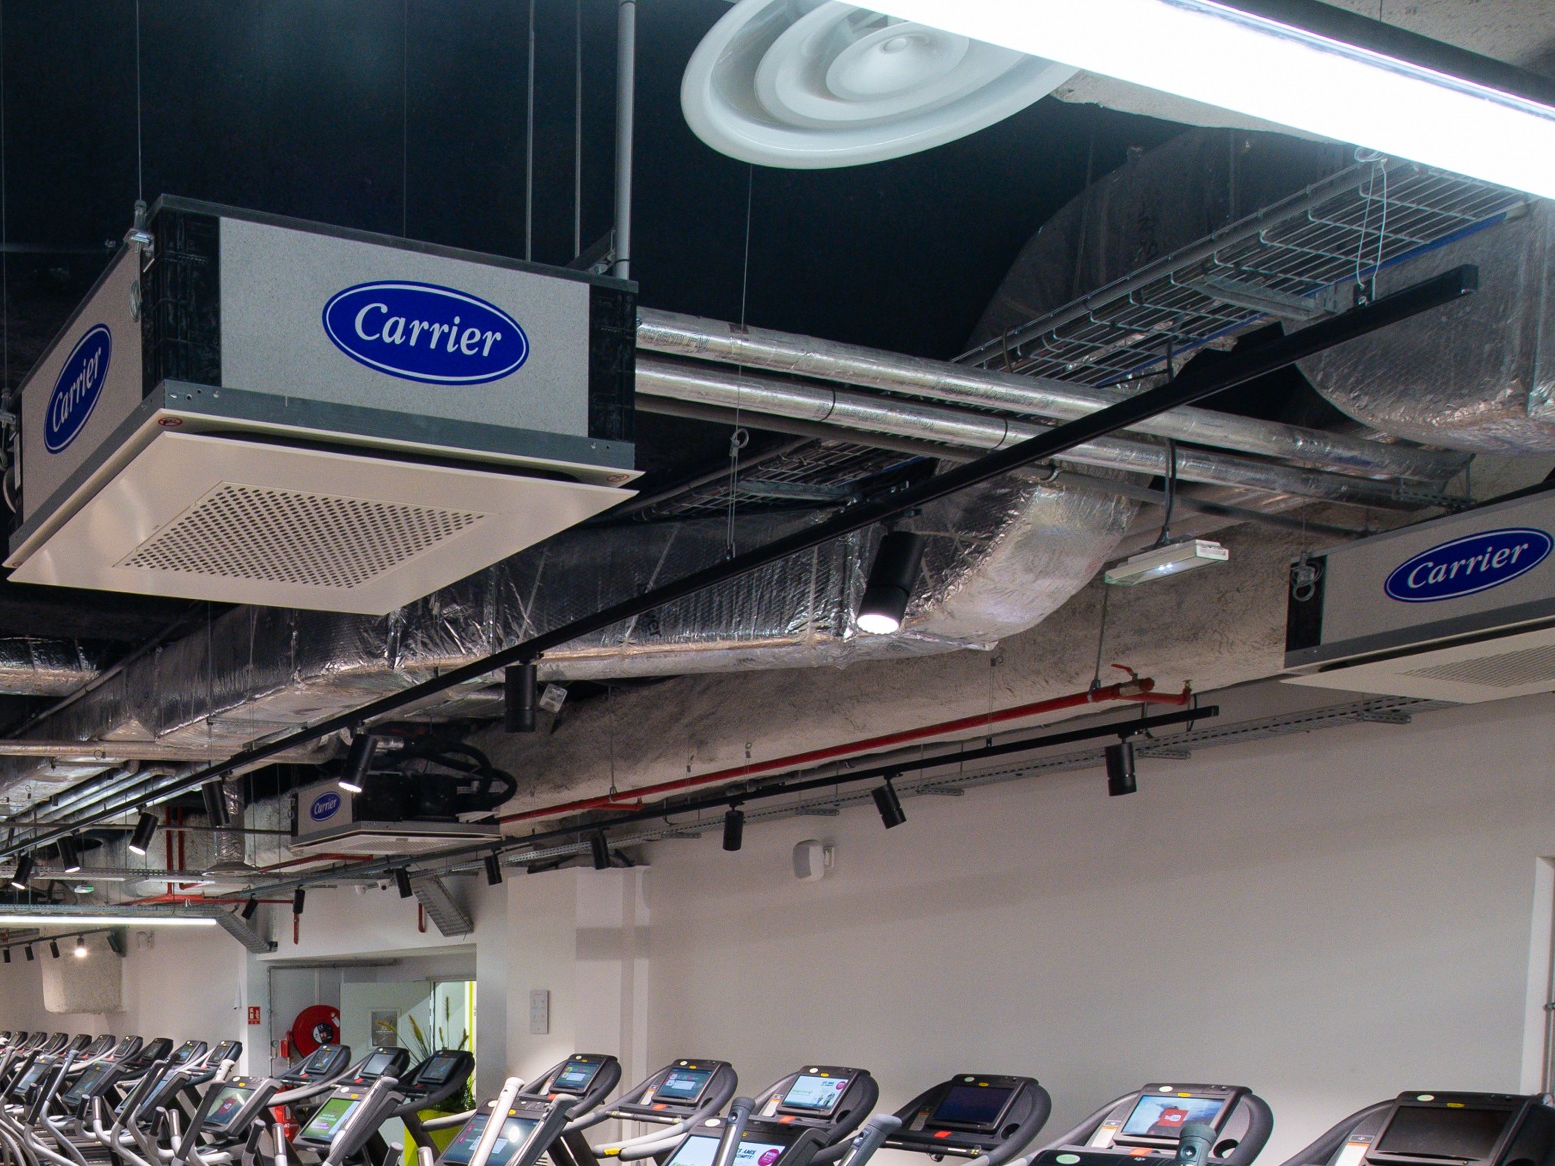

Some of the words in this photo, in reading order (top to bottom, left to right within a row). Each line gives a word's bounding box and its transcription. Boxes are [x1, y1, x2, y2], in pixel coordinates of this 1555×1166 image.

[355, 303, 502, 357] Carrier
[52, 347, 101, 432] Carrier
[1407, 543, 1529, 589] Carrier
